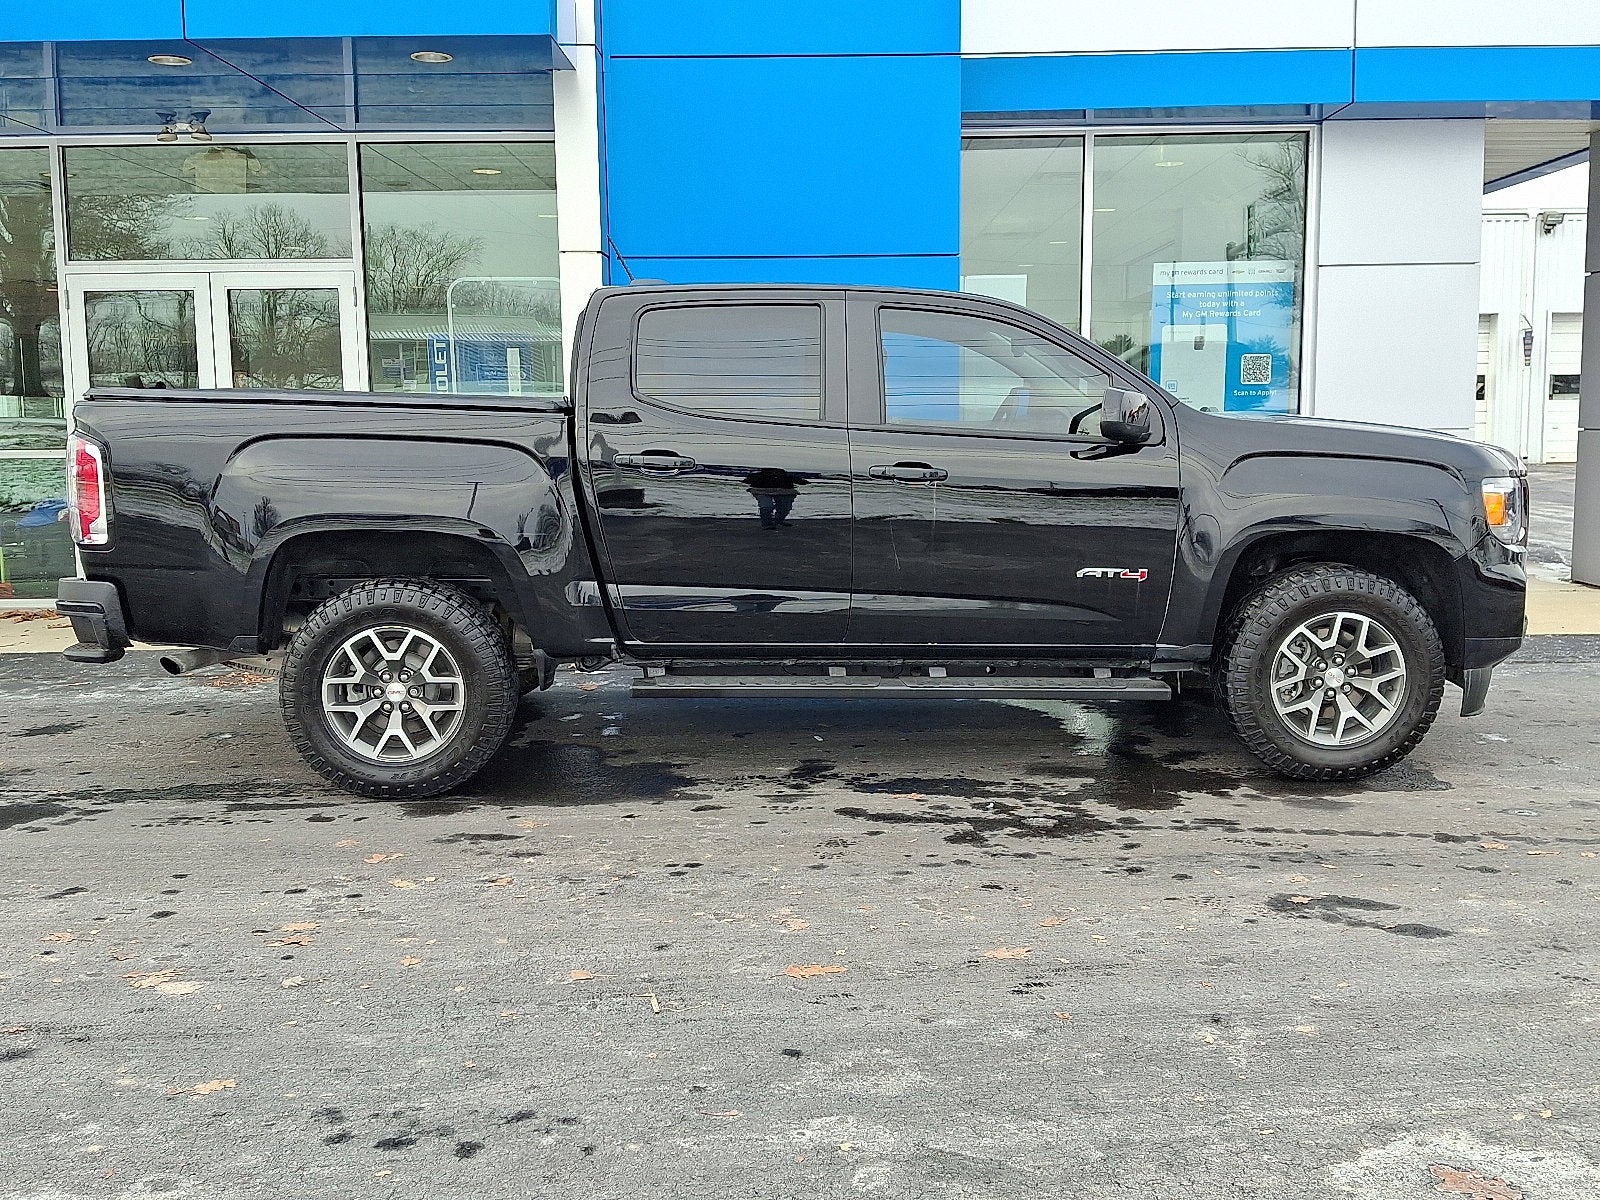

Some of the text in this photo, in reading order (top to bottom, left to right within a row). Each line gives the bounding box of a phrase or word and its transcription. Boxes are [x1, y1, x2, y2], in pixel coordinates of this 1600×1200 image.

[1166, 289, 1279, 299] Start earning unlimited points
[1199, 300, 1220, 309] today
[1221, 299, 1238, 307] with
[1182, 310, 1193, 319] My
[1243, 309, 1262, 317] Card
[434, 338, 449, 394] OLET
[1233, 389, 1249, 397] Scan
[1257, 389, 1278, 398] Apply!
[1076, 567, 1149, 583] AT4
